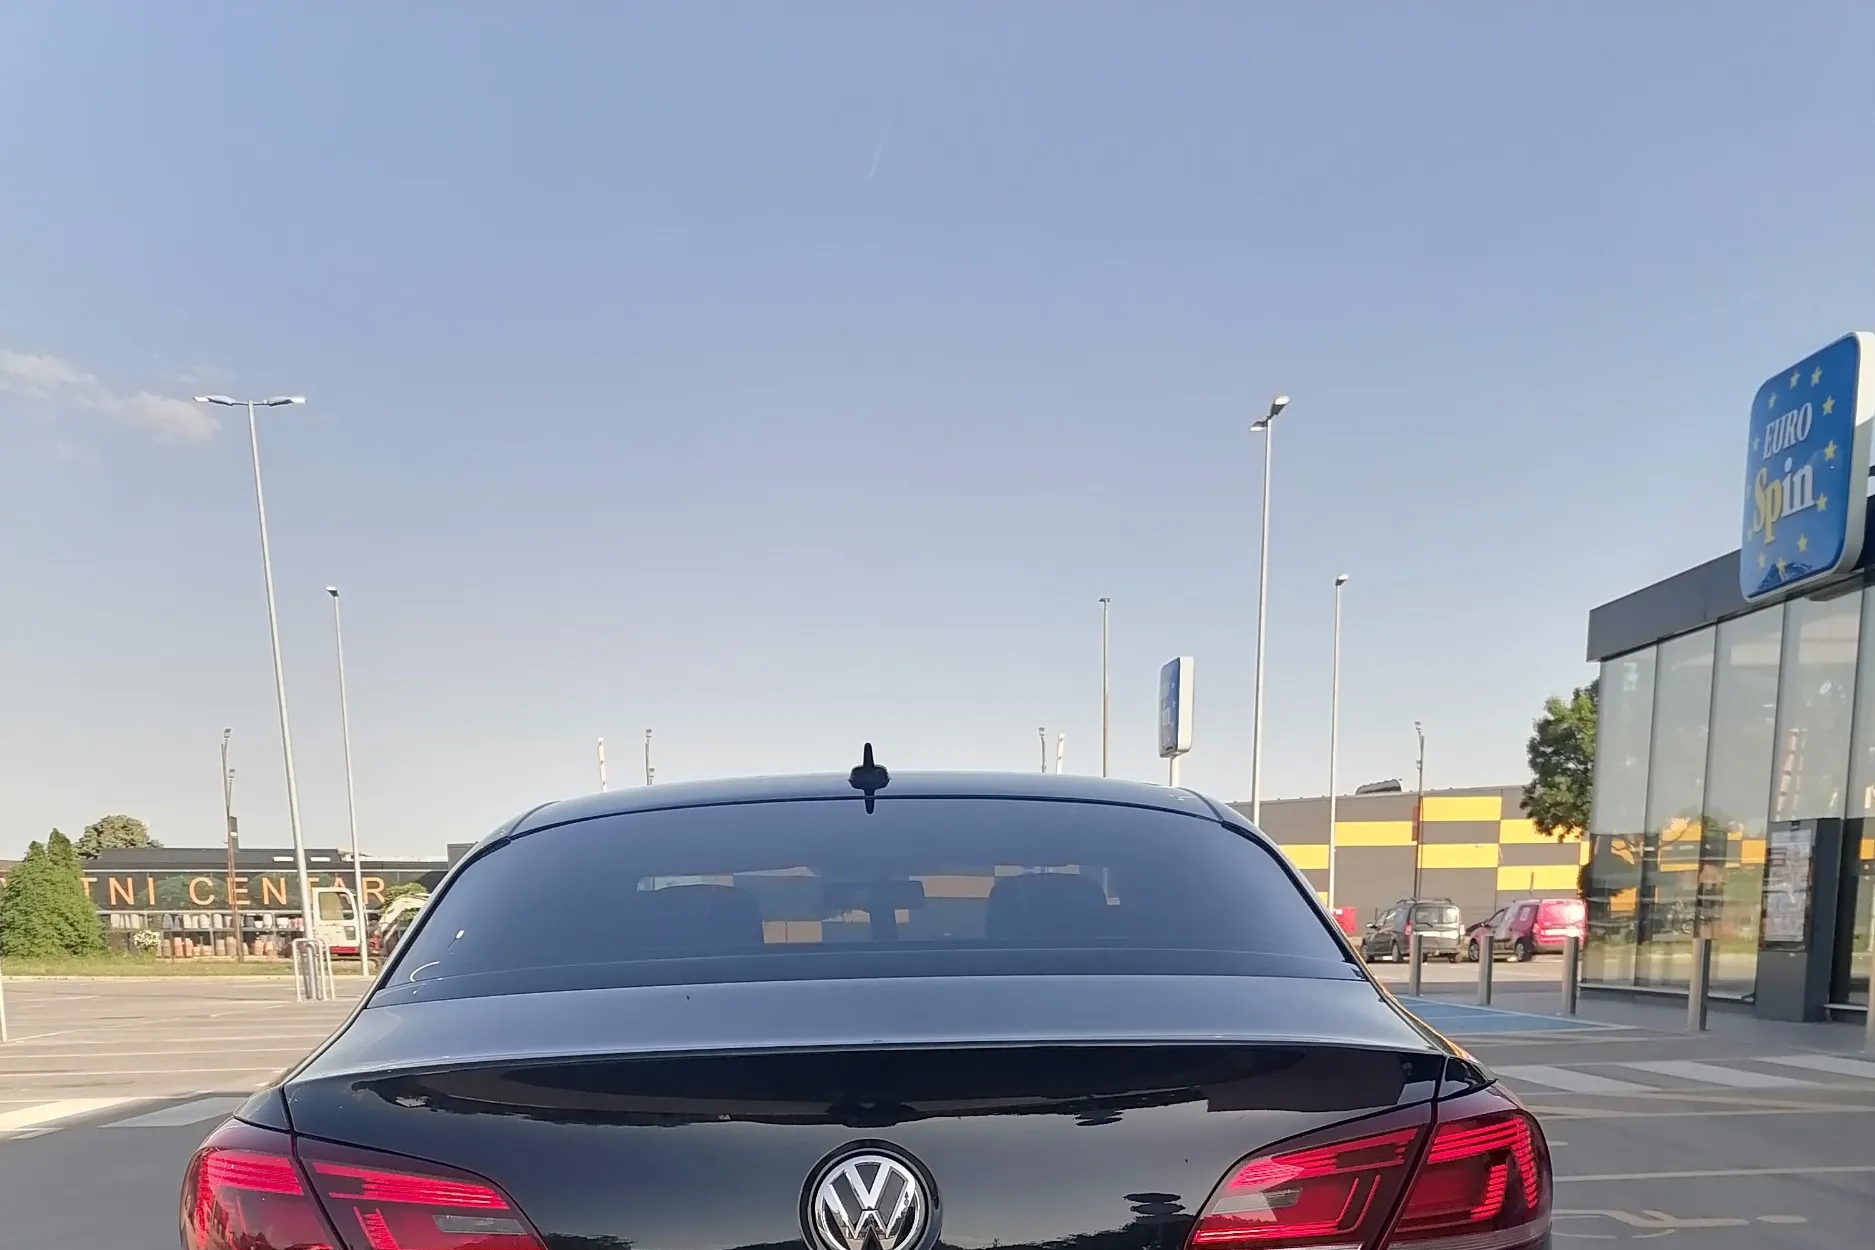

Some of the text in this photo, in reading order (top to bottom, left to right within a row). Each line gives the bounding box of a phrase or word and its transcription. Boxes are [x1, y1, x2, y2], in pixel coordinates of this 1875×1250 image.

[1763, 402, 1812, 460] EURO
[1753, 457, 1817, 544] Spin
[80, 877, 155, 905] TNI
